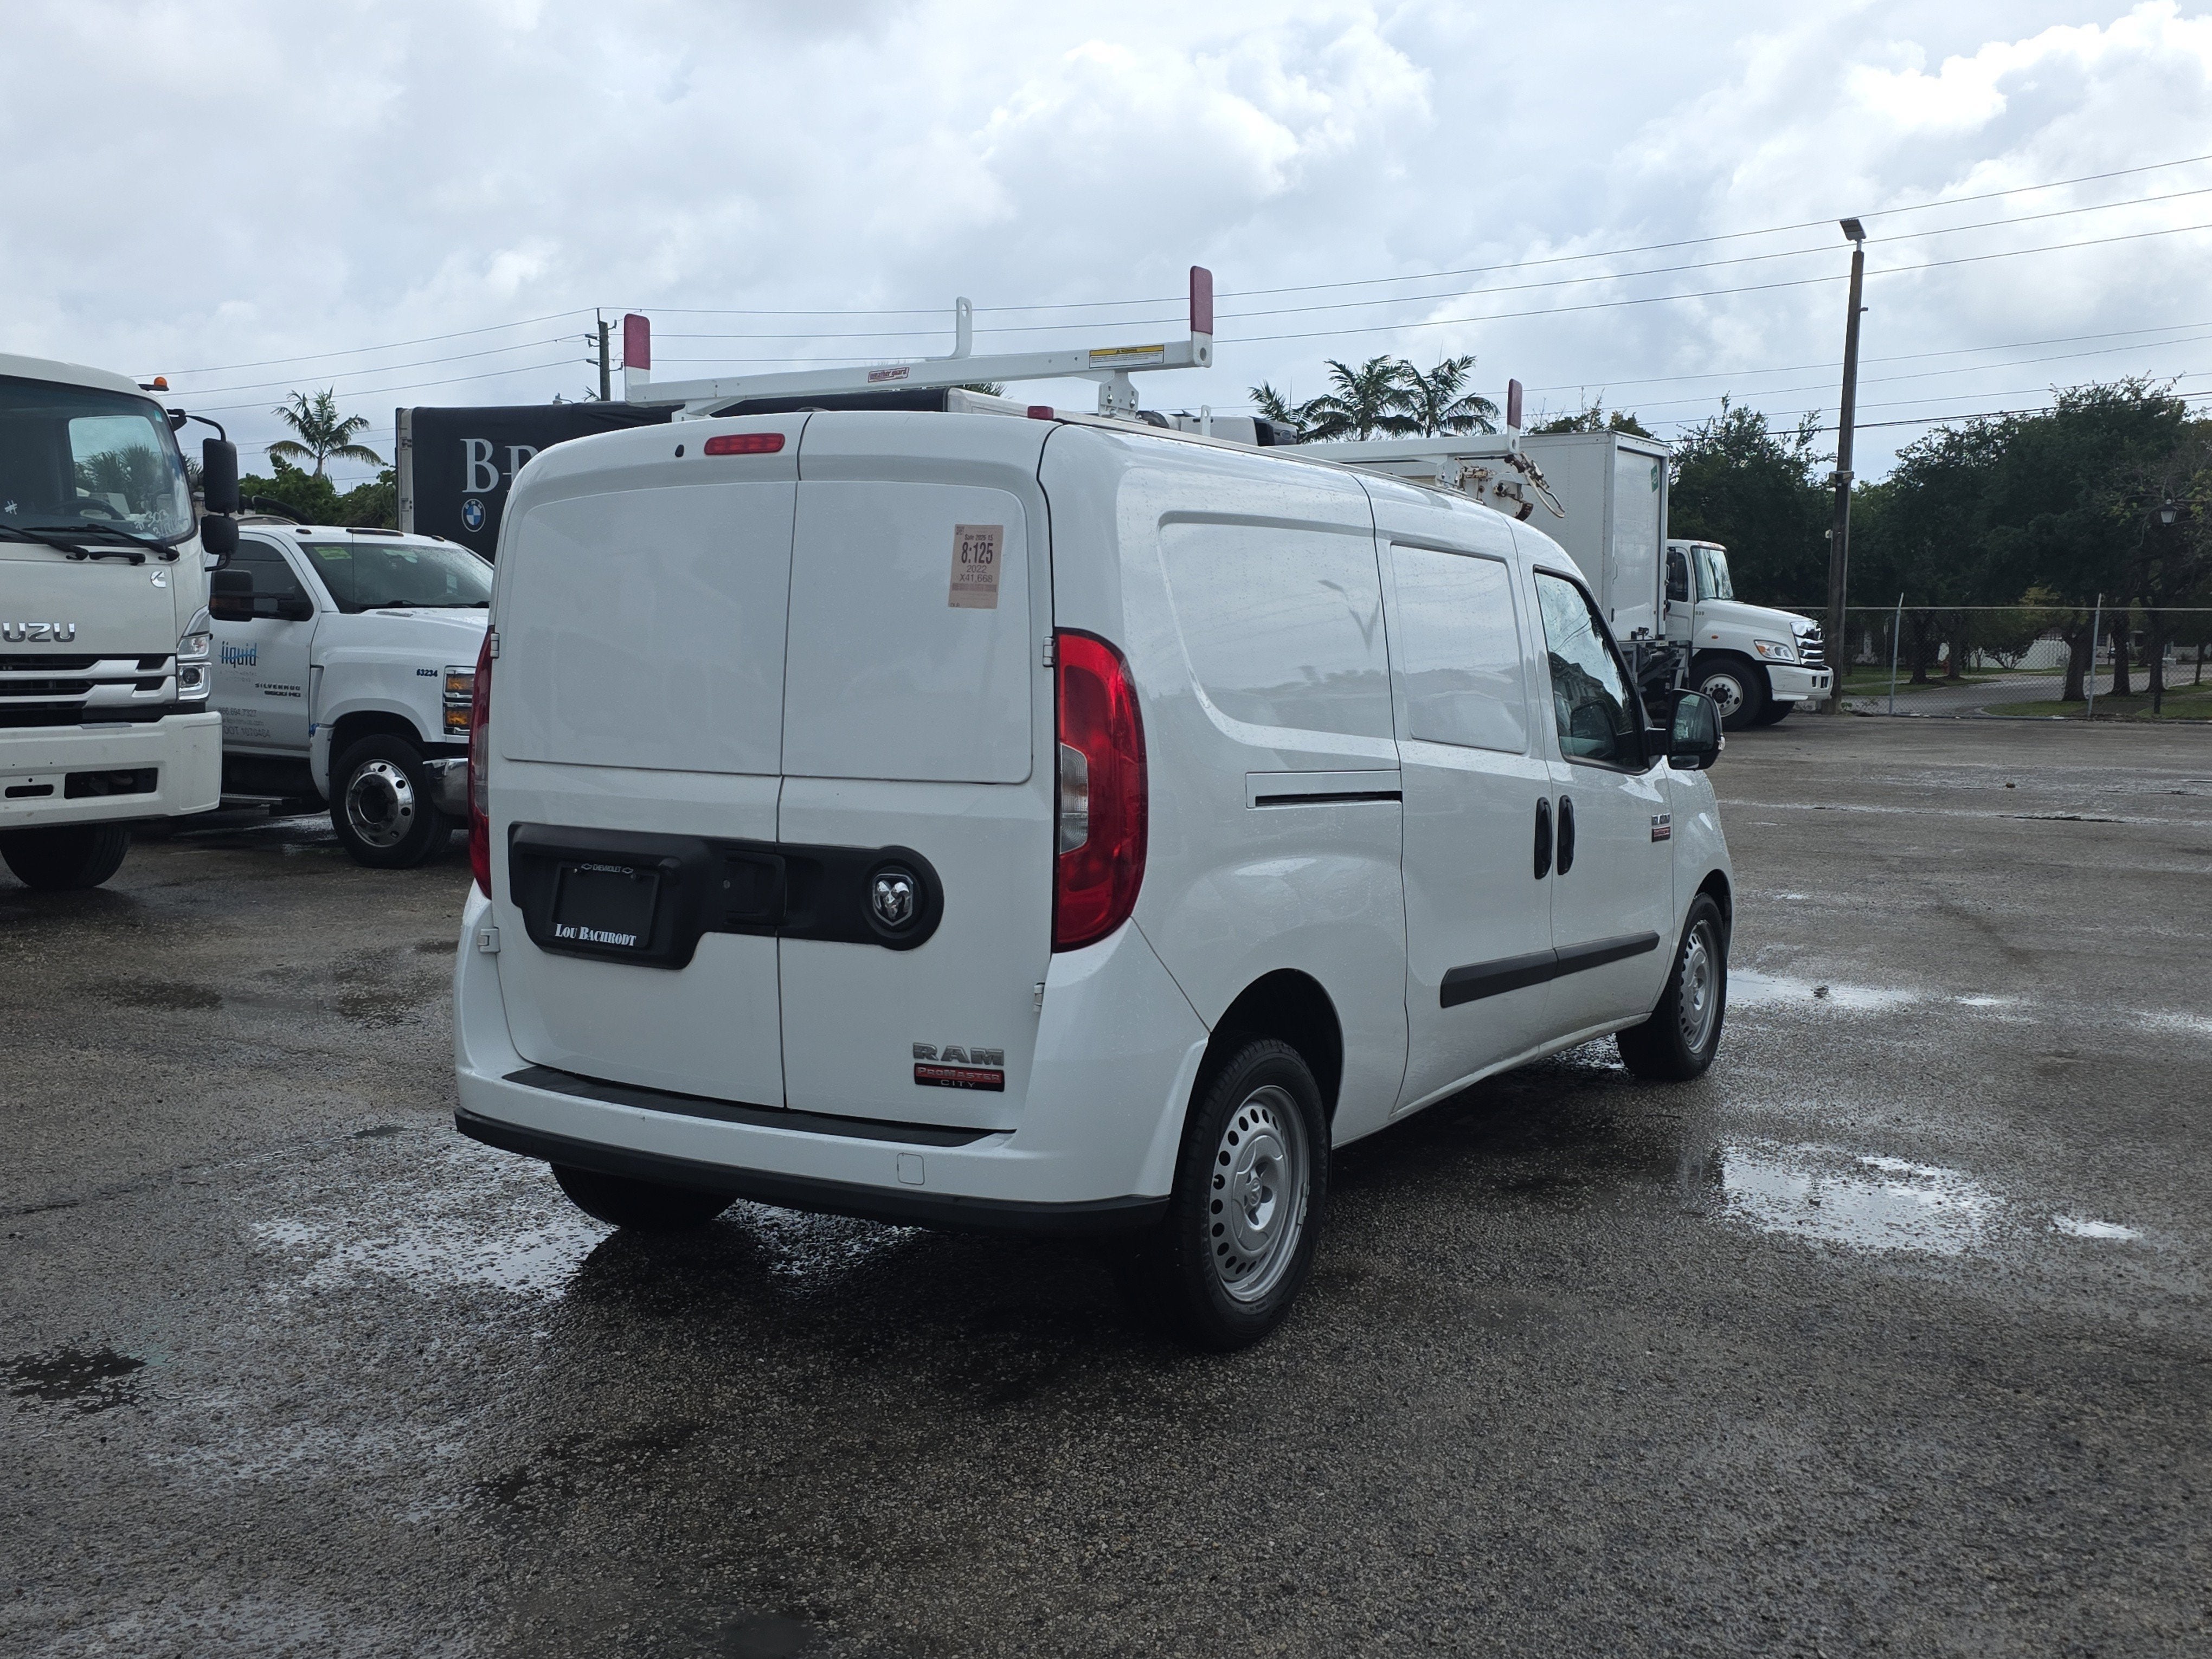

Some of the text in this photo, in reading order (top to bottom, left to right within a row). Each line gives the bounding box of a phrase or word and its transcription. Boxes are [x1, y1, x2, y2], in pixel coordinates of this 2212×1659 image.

[961, 542, 993, 564] 8:125
[967, 564, 987, 573] 2022
[1, 622, 75, 642] UZU
[220, 641, 259, 668] liquid
[913, 1043, 1005, 1066] RAM
[941, 1079, 976, 1088] CITY
